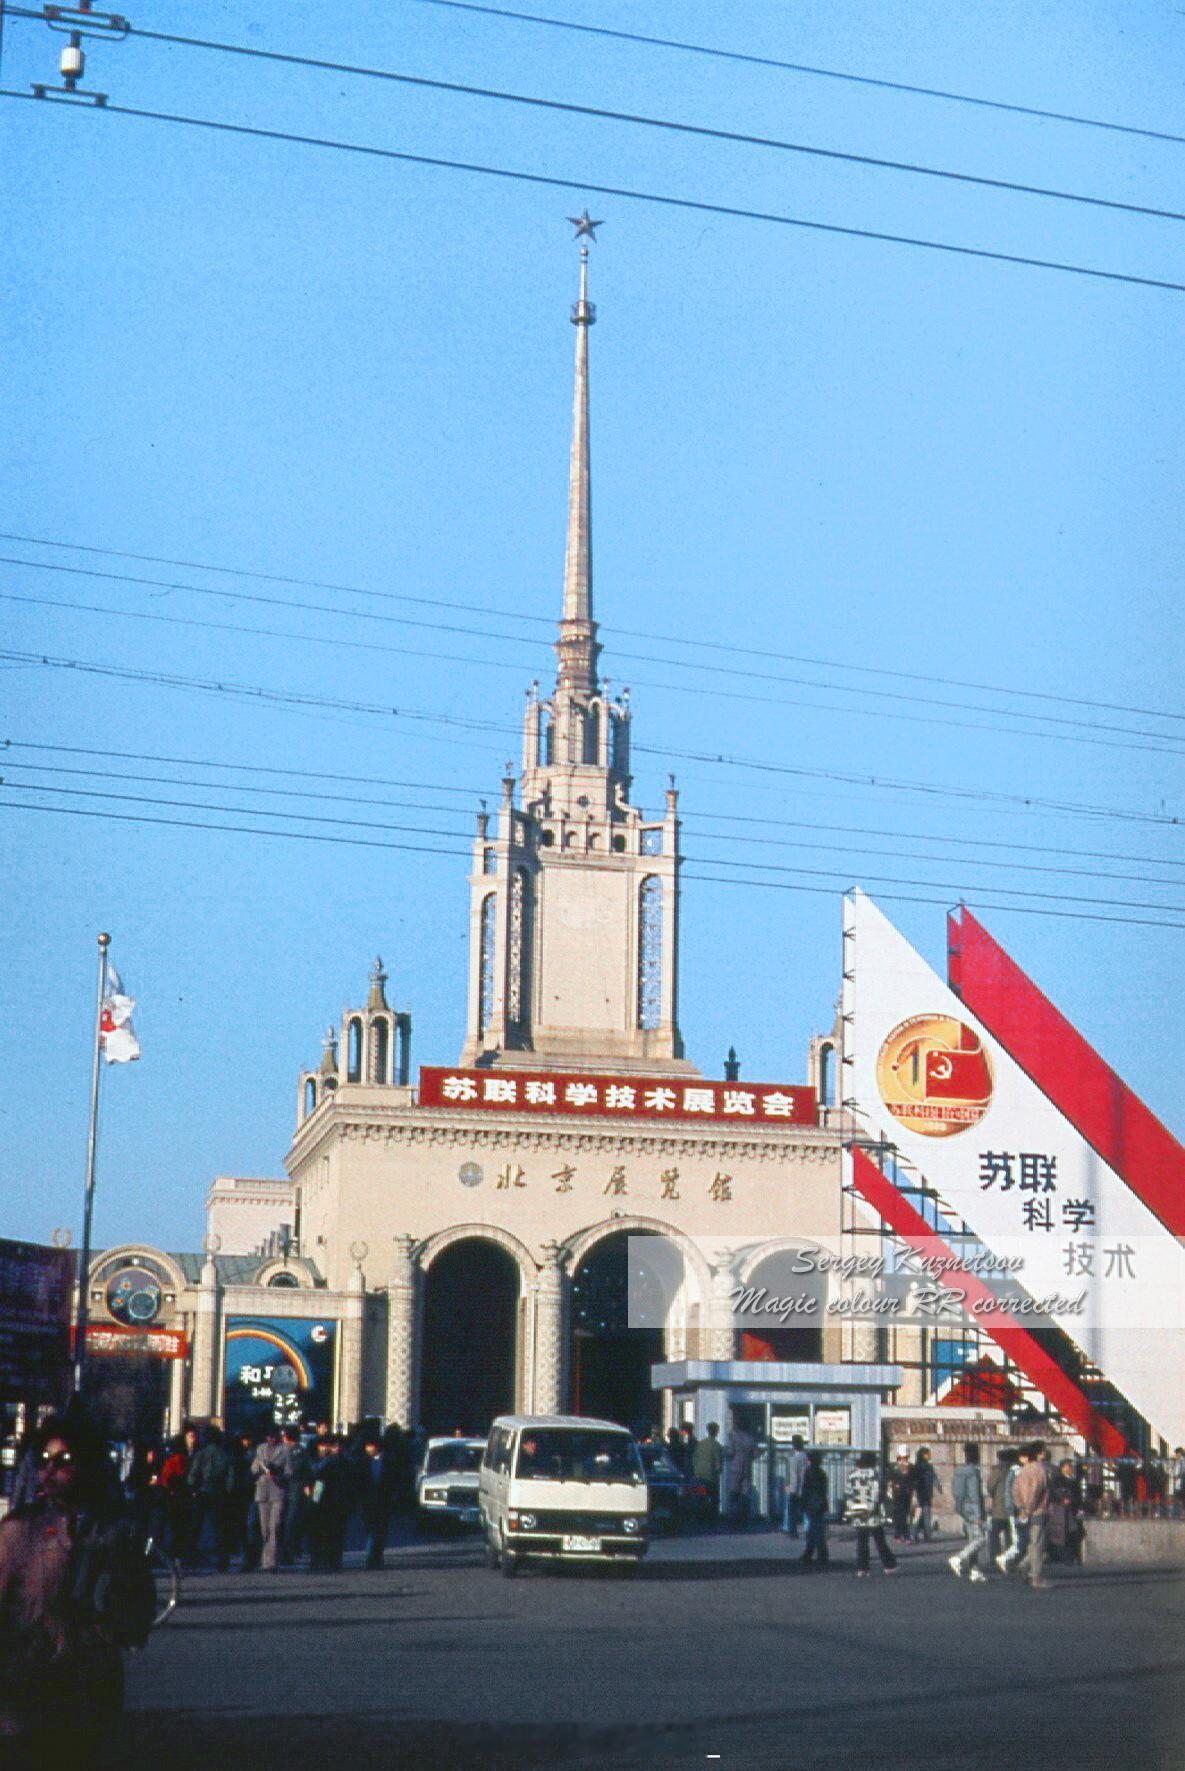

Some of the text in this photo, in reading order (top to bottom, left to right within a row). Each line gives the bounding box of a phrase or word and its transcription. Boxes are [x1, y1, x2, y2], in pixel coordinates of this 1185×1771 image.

[442, 1076, 795, 1117] 苏联科学技术展览会
[978, 1150, 1057, 1193] 苏联
[1022, 1197, 1097, 1233] 科学
[1062, 1241, 1136, 1279] 技术
